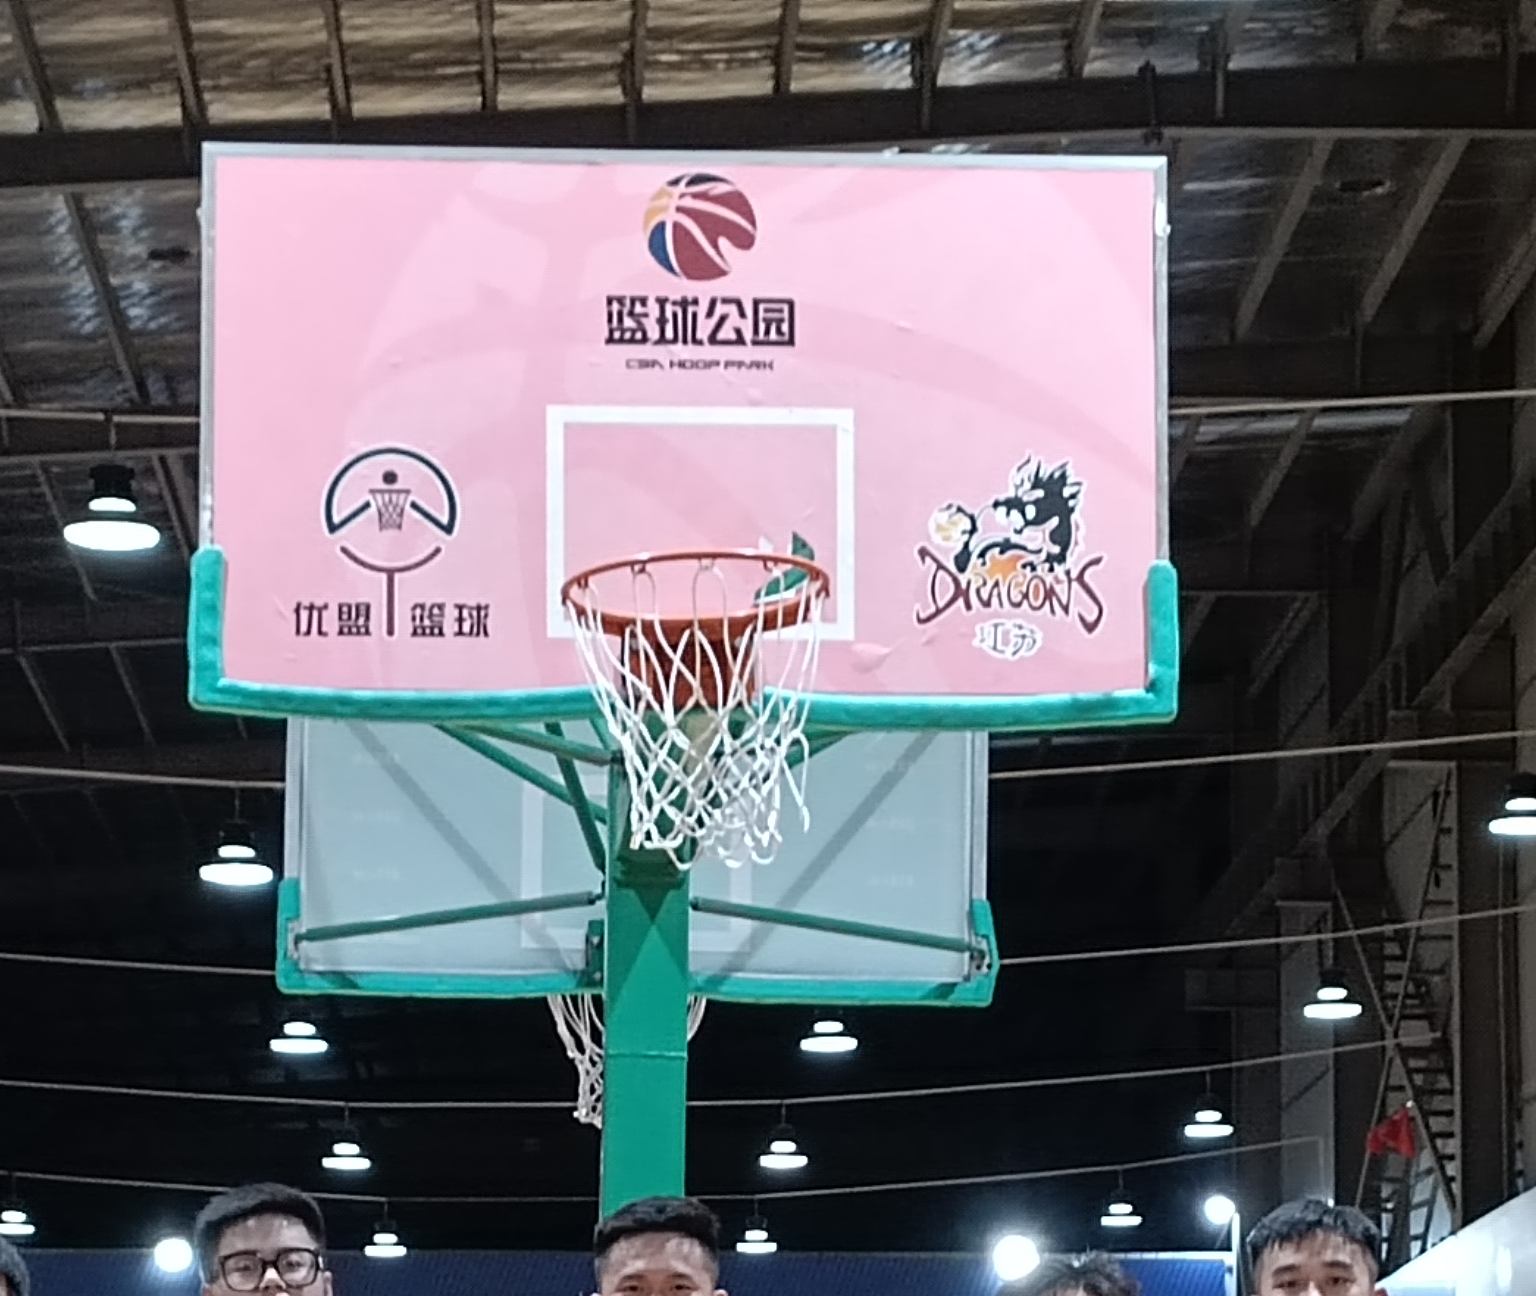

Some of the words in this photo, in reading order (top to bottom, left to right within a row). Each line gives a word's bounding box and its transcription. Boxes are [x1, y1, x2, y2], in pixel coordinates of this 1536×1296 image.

[605, 295, 796, 347] 篮球公园
[625, 358, 664, 370] CBA
[669, 358, 720, 370] HOOP
[724, 358, 774, 371] PARK
[916, 546, 1104, 634] DRAGONS
[294, 601, 372, 637] 优盟
[410, 601, 490, 637] 篮球
